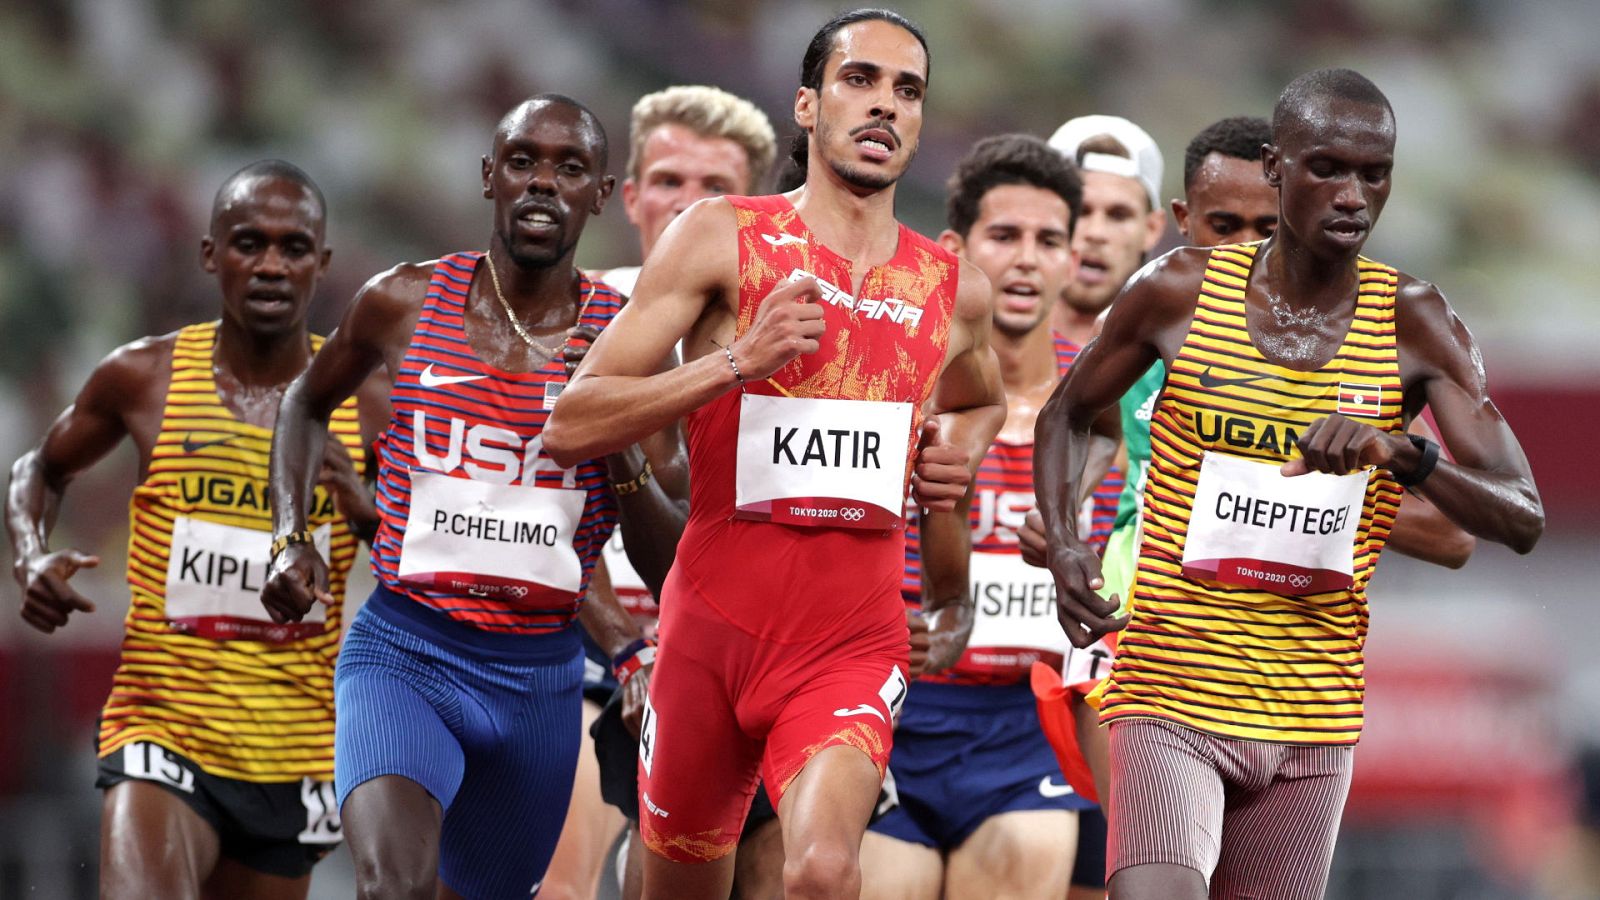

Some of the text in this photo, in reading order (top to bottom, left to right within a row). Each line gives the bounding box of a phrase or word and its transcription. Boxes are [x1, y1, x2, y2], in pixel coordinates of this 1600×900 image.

[772, 426, 881, 469] KATIR
[433, 509, 558, 547] P.CHELIMO
[789, 506, 838, 518] TOKYO 2020
[1215, 492, 1350, 535] CHEPTEGEI
[1236, 566, 1286, 583] TOKYO 2020
